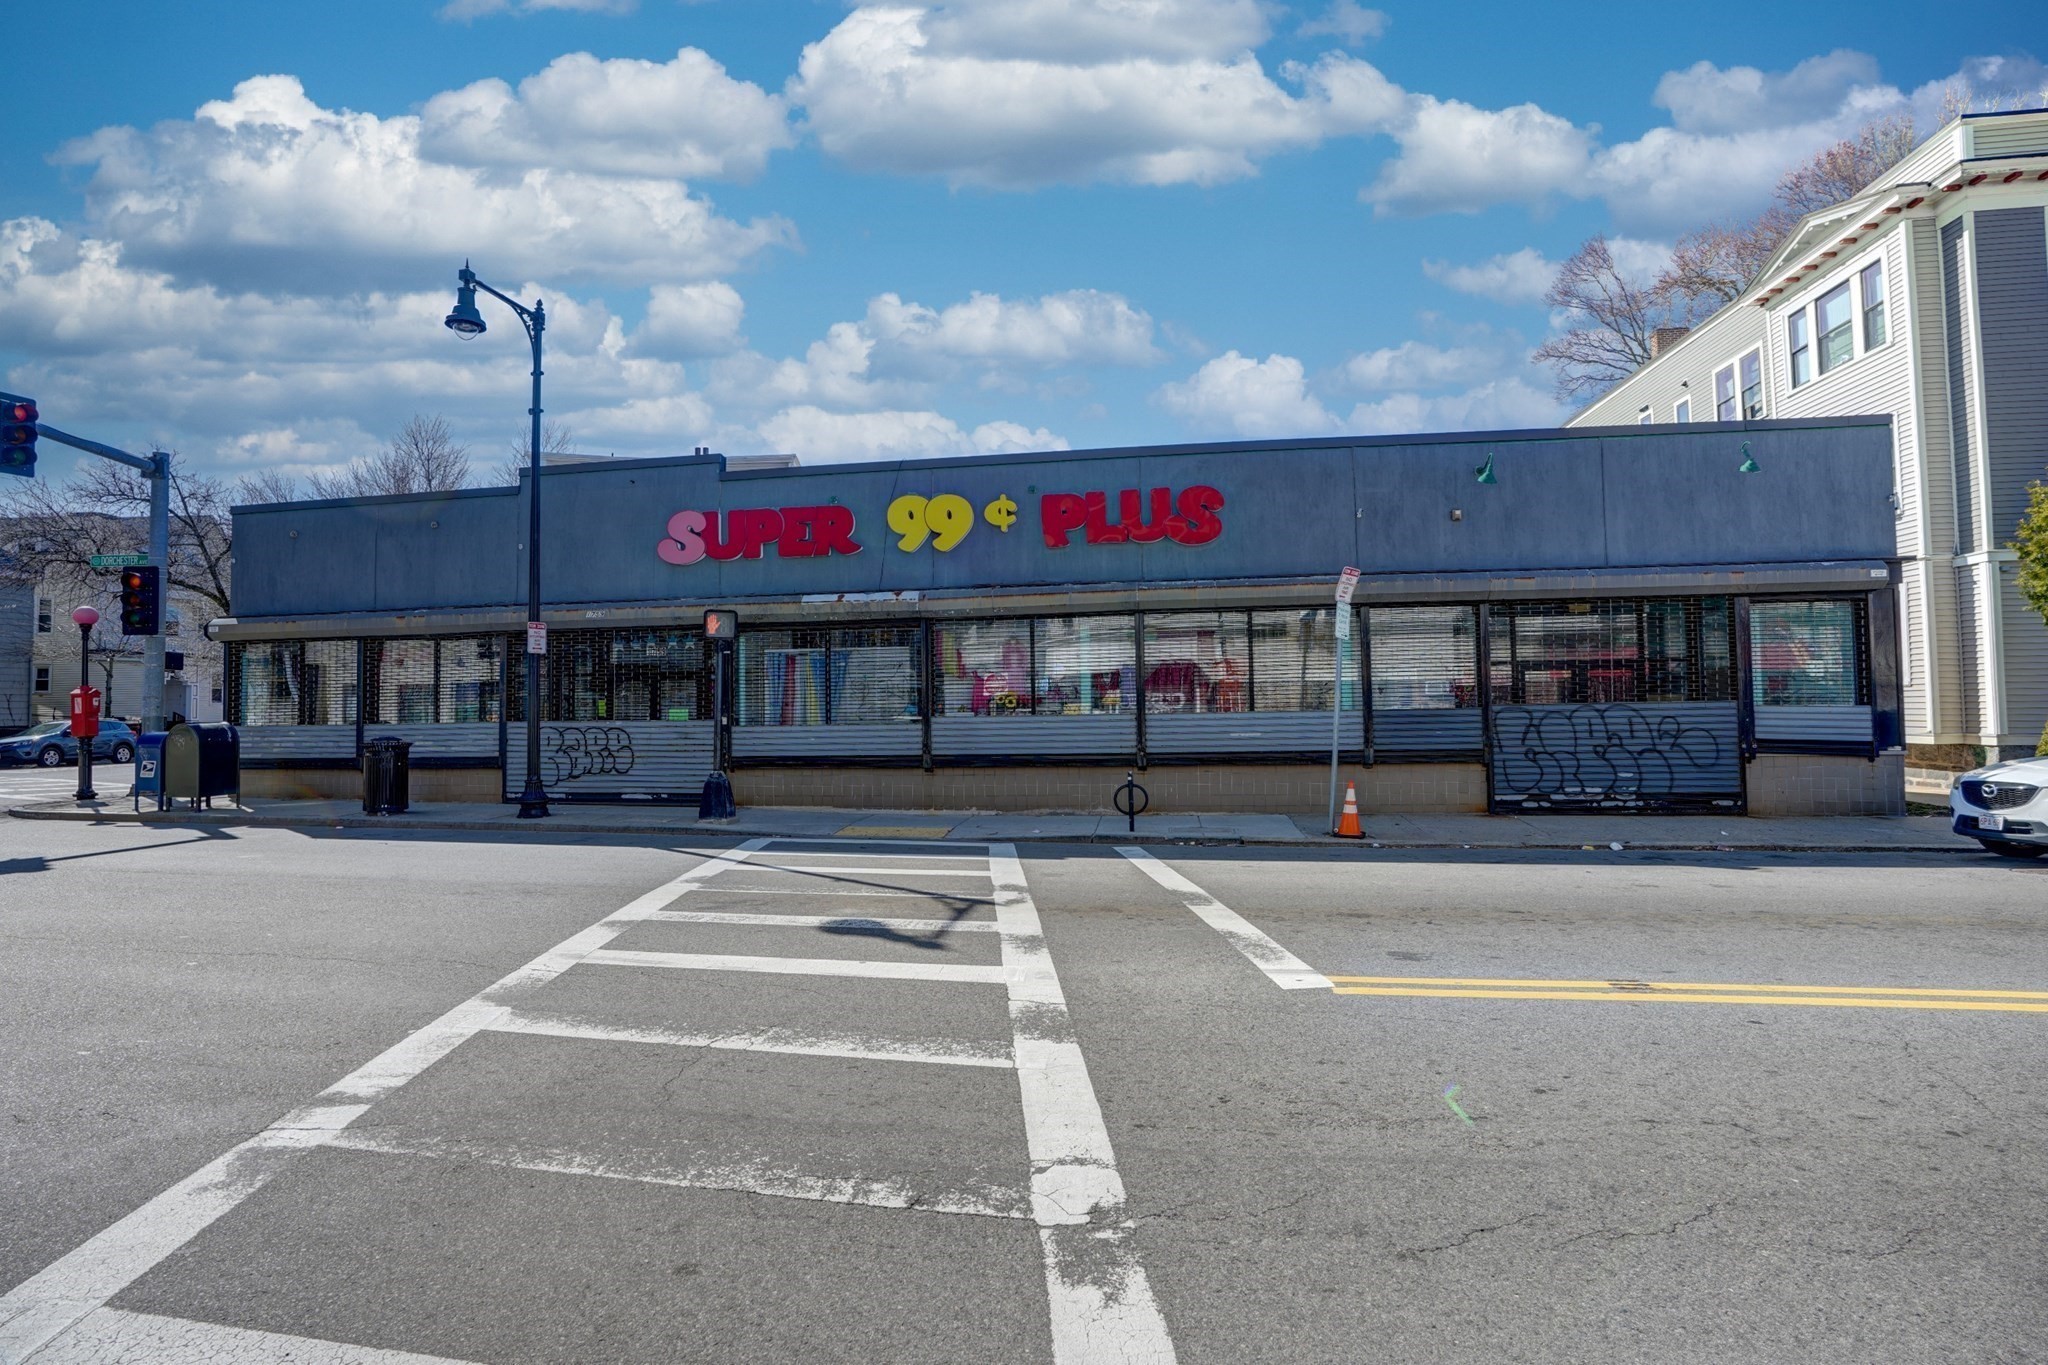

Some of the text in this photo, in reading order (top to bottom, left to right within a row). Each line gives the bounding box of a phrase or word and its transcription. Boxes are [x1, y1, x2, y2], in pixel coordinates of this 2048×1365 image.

[657, 505, 863, 565] SUPER
[1041, 485, 1225, 549] PLUS
[101, 556, 139, 566] DORCHESTER
